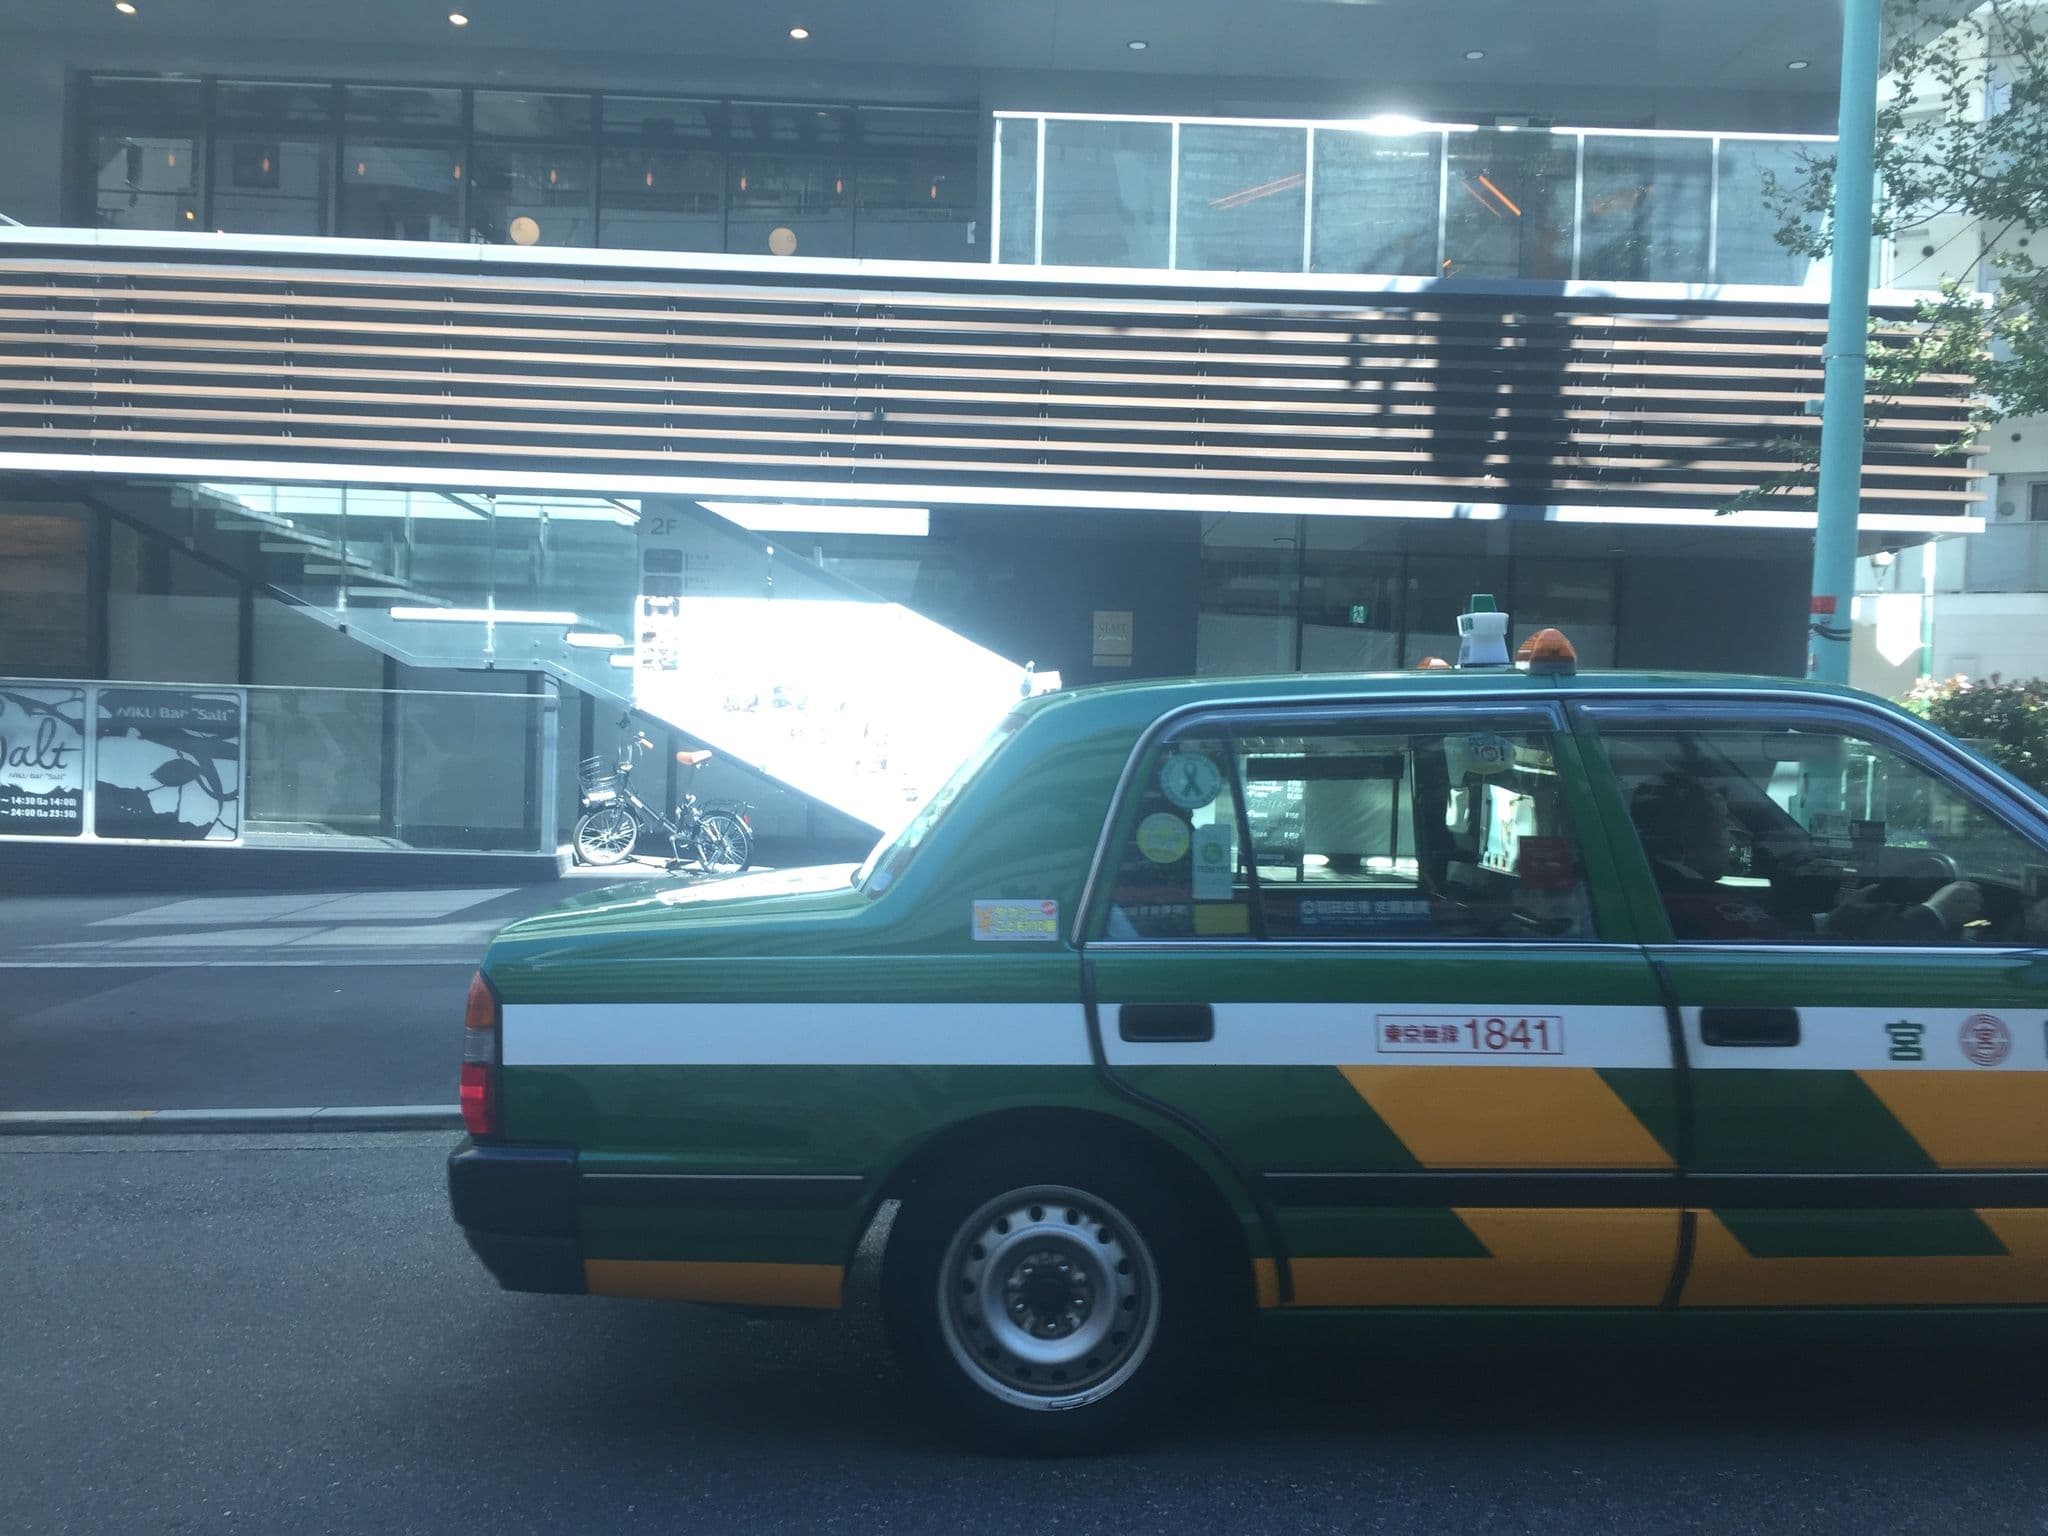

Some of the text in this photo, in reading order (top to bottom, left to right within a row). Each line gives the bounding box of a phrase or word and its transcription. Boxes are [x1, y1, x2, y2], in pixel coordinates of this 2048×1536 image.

[651, 517, 677, 535] 2F
[160, 707, 189, 719] Bar
[0, 702, 82, 771] alt
[11, 797, 36, 805] 14:30
[10, 808, 36, 817] 24:00
[1464, 1018, 1549, 1050] 1841
[1885, 1020, 1925, 1061] 宮
